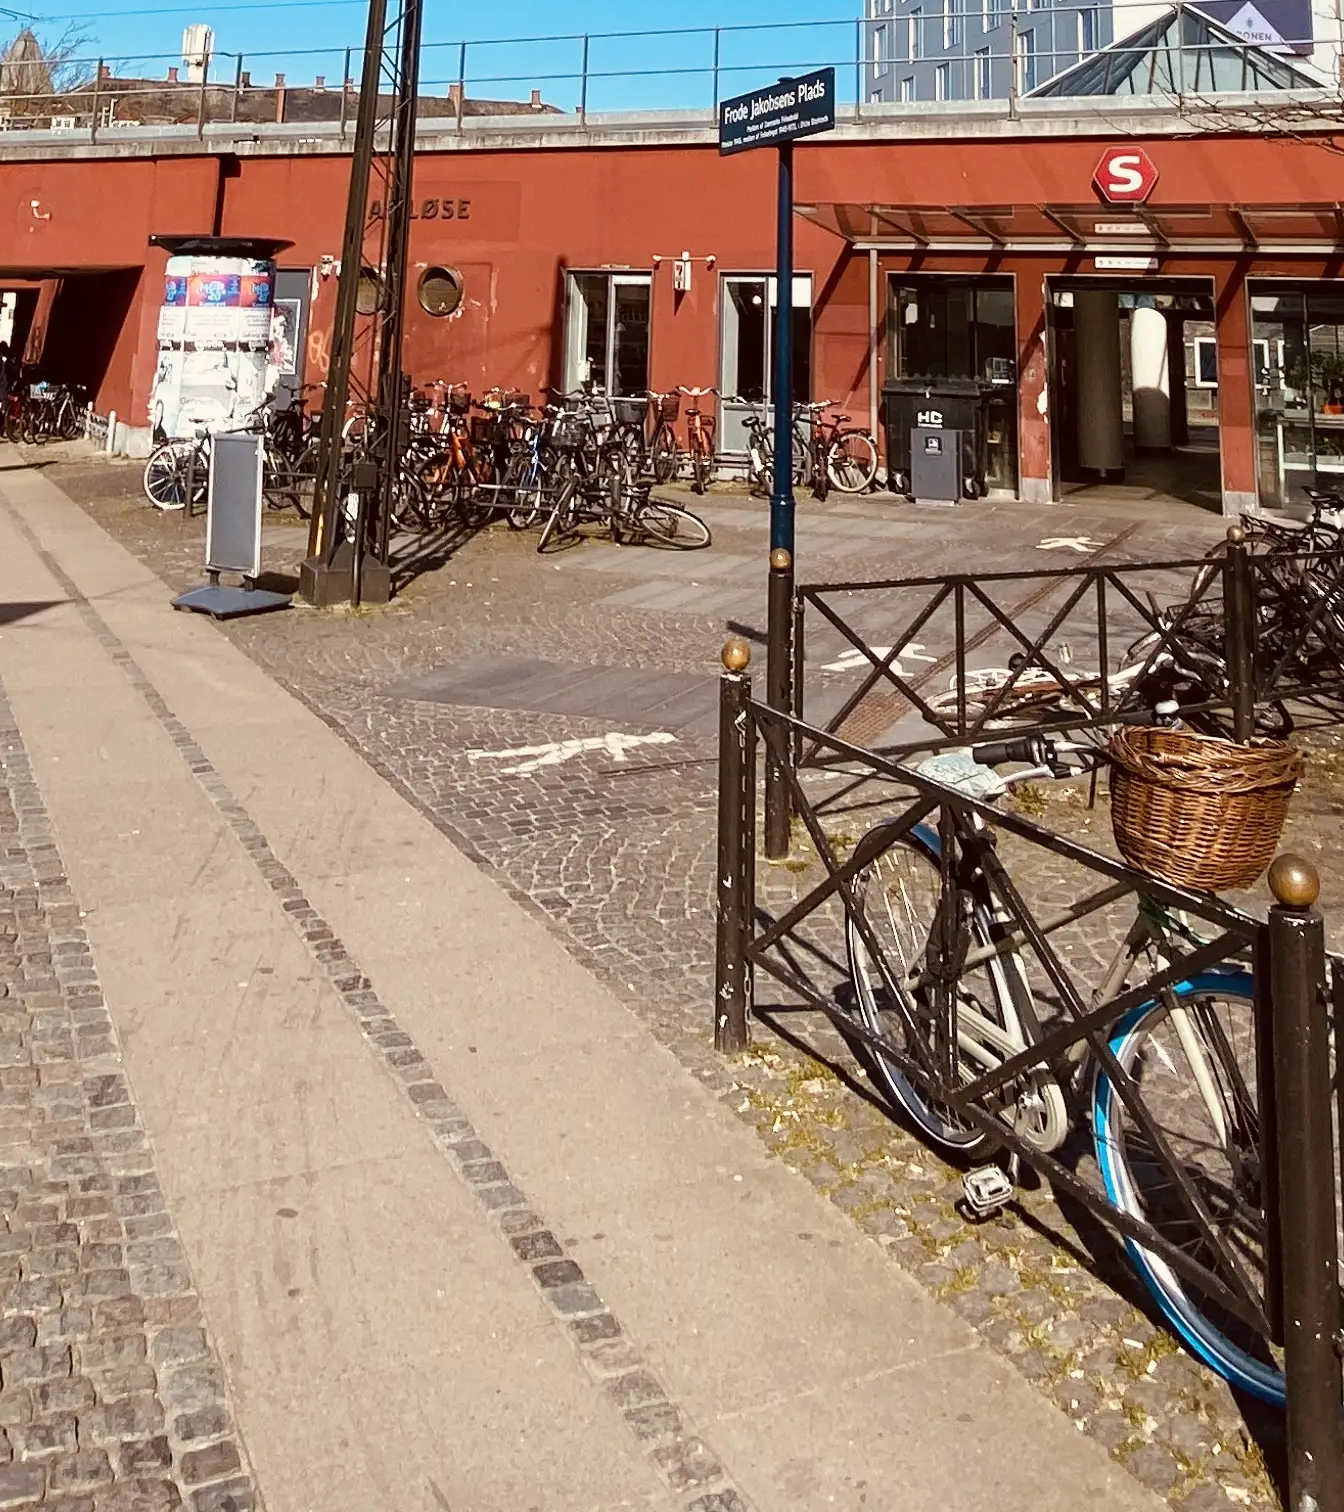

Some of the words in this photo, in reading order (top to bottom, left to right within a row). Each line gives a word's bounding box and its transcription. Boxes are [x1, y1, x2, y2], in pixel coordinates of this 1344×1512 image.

[1236, 31, 1272, 42] ONEN
[724, 103, 748, 125] Frode
[749, 91, 795, 120] Jakobsens
[798, 79, 825, 103] Plads
[1108, 155, 1143, 193] S
[367, 199, 471, 220] ALØSE
[917, 410, 943, 423] HC
